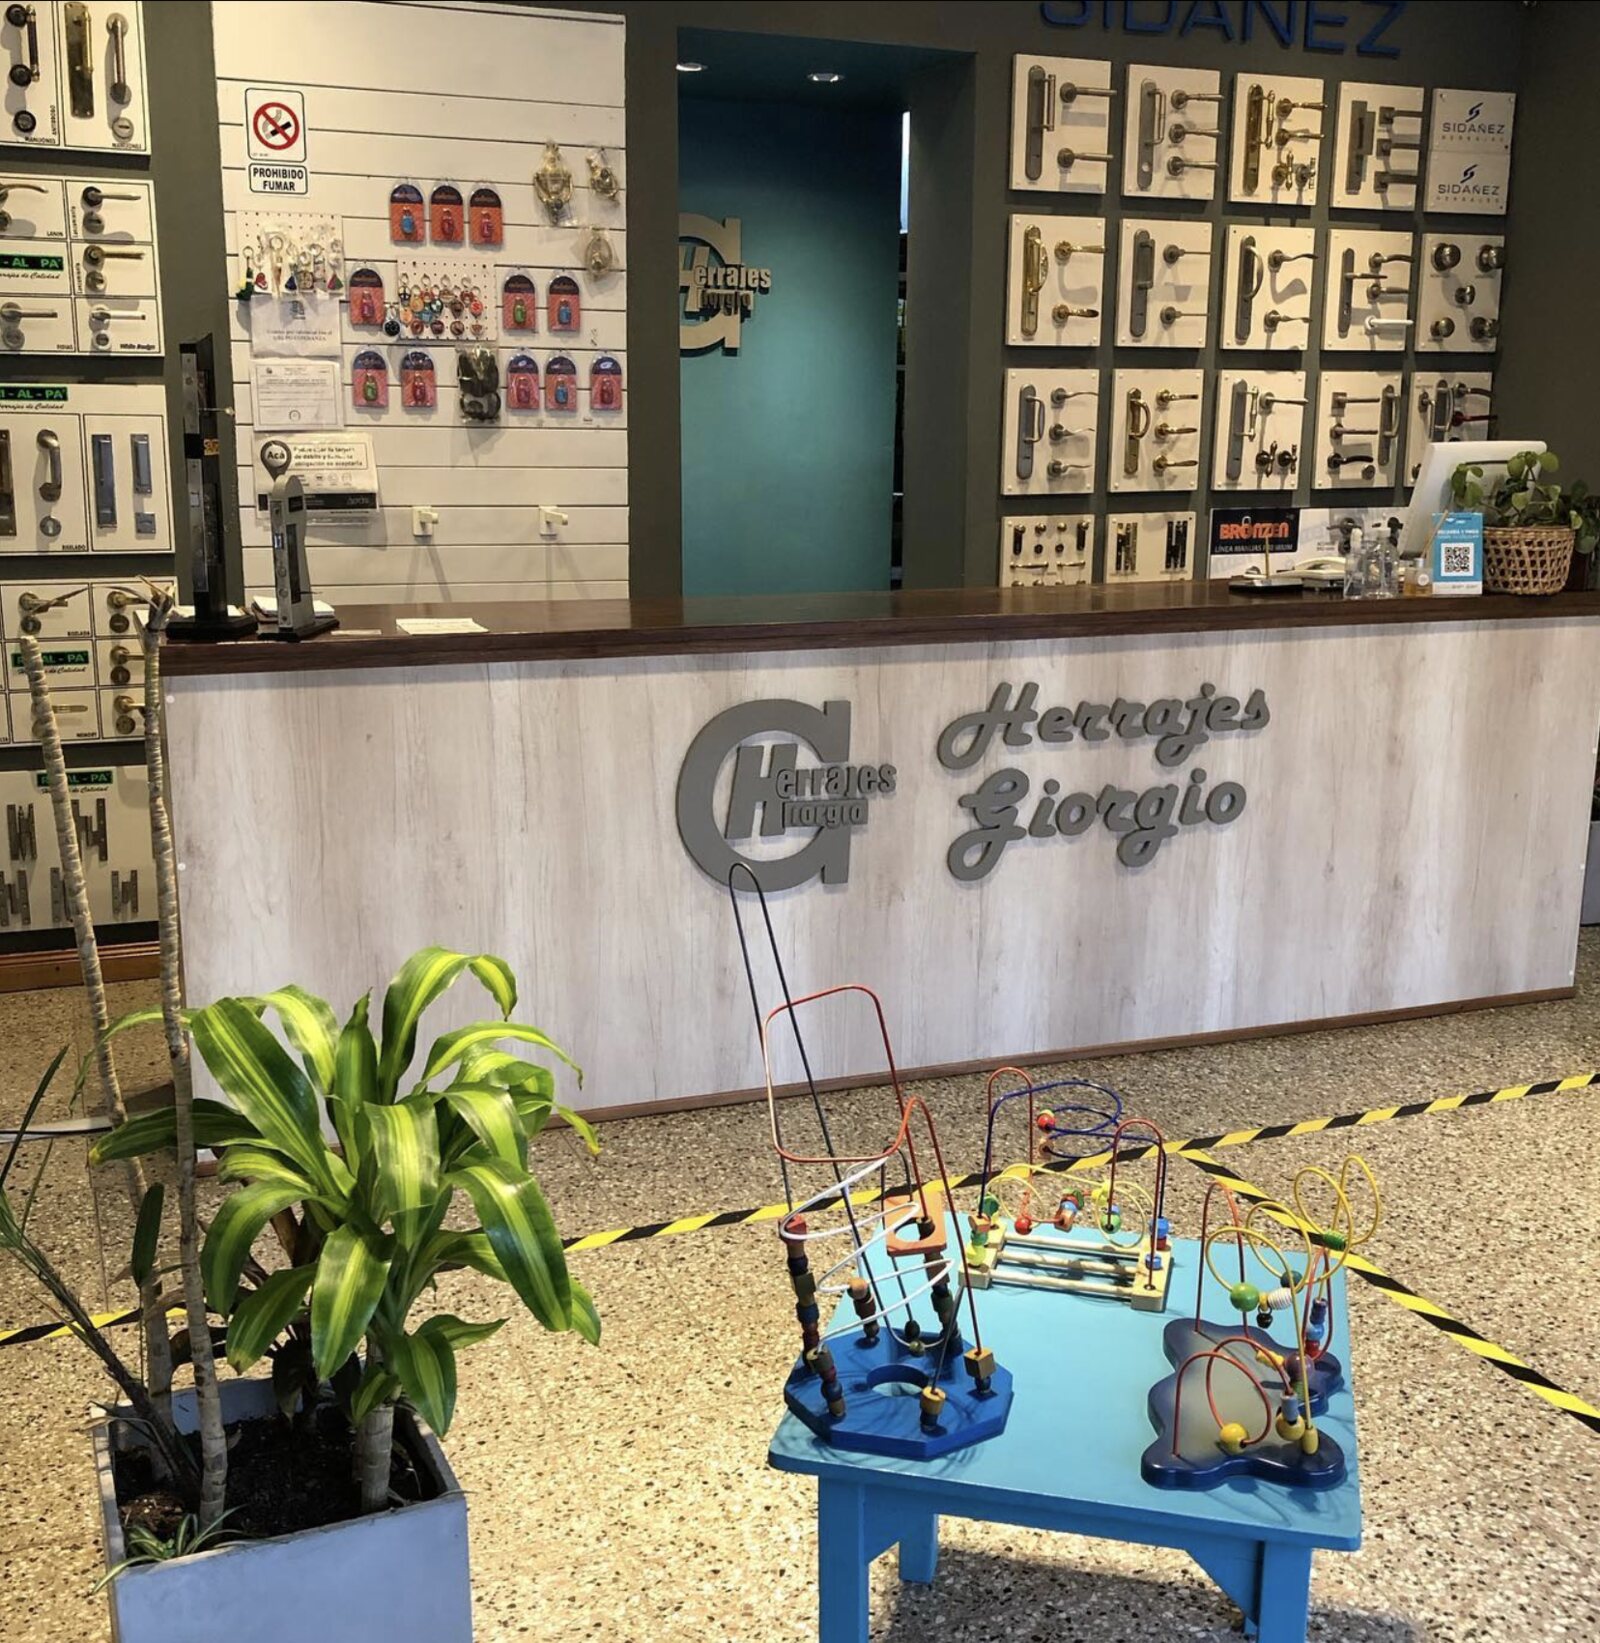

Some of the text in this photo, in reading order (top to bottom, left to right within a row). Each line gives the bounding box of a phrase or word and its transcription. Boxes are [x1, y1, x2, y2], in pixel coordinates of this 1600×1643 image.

[253, 167, 304, 180] PROHIBIDO
[262, 180, 296, 192] FUMAR
[267, 451, 285, 460] Acá
[937, 682, 1271, 769] Herrajes
[947, 768, 1247, 882] Giorgio
